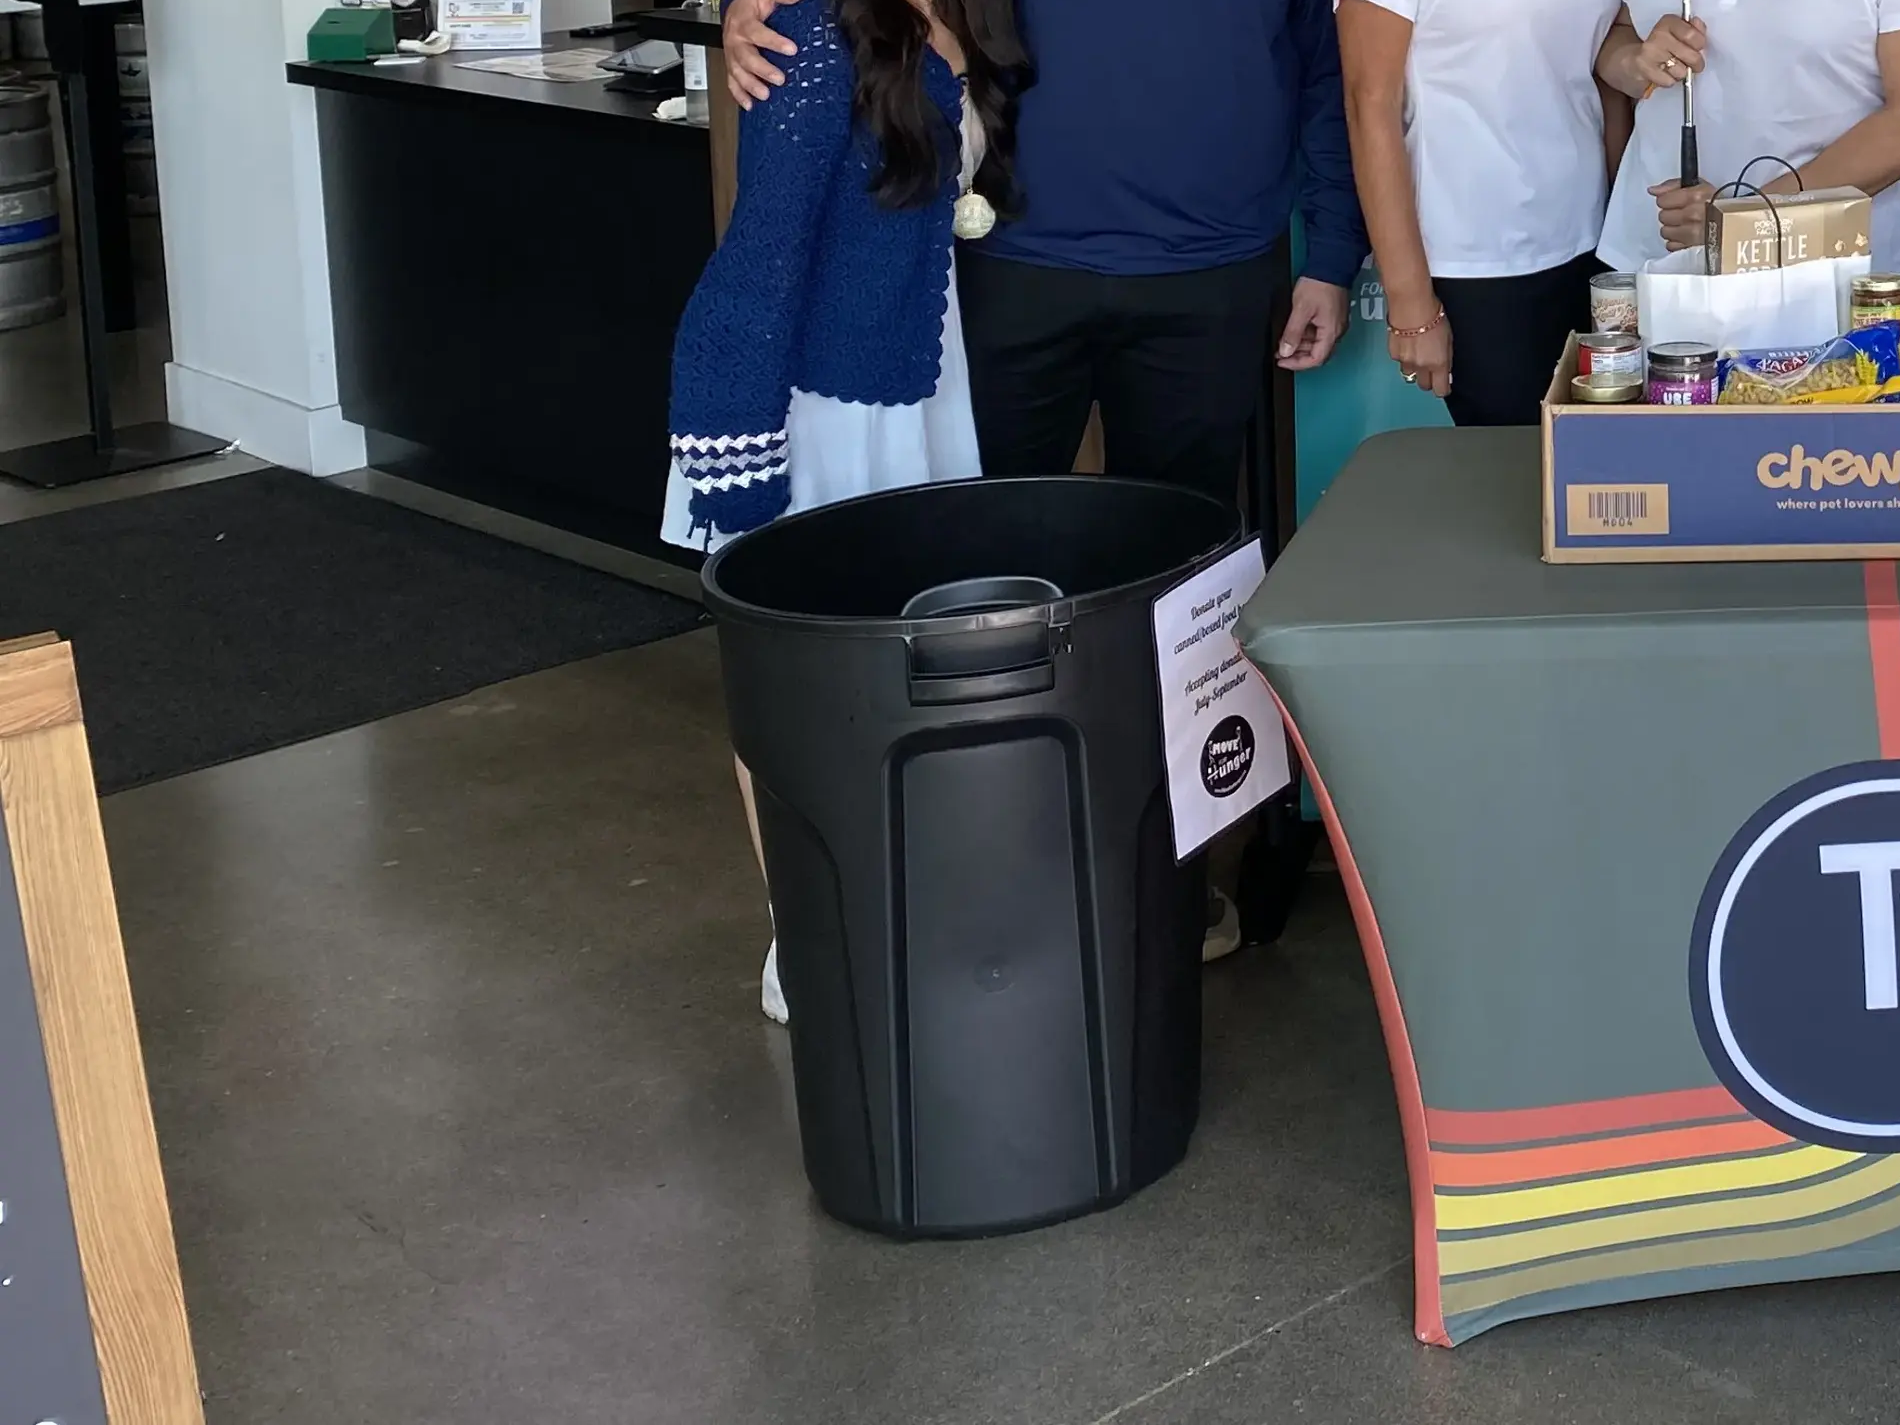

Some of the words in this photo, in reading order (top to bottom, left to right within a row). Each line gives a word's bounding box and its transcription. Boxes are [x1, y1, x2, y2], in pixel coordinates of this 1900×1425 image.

[1664, 392, 1692, 405] UBE
[1777, 498, 1817, 509] where
[1819, 499, 1841, 511] pet
[1845, 497, 1883, 509] lovers
